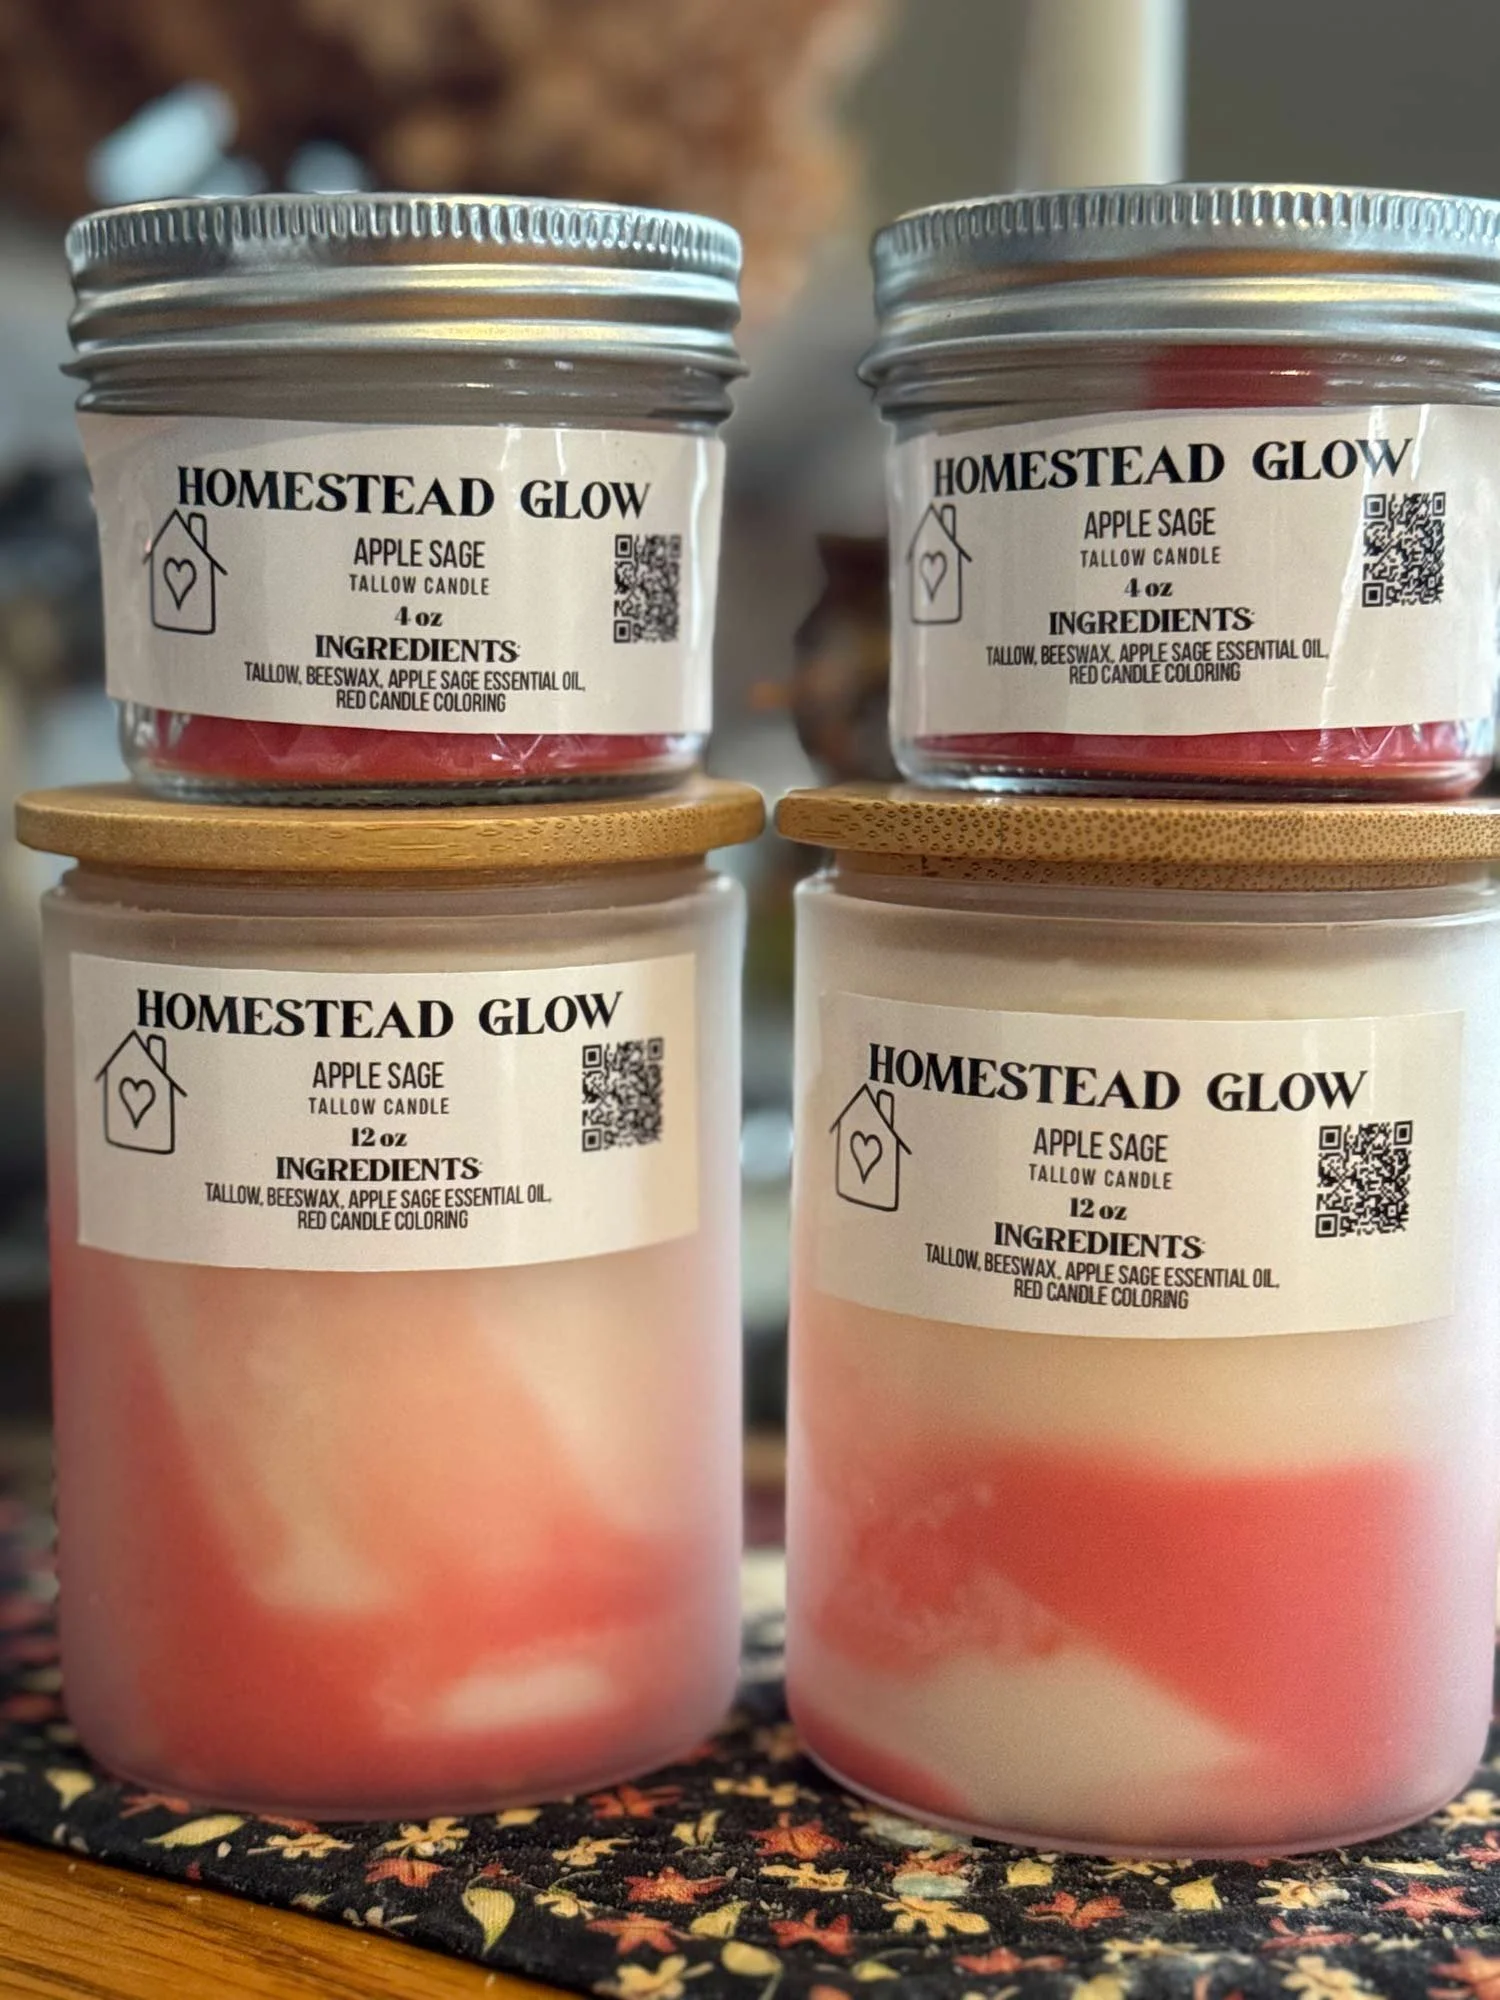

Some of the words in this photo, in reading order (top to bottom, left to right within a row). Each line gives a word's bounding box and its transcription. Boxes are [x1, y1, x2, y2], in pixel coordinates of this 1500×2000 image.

[934, 443, 1225, 497] HOMESTEAD
[1252, 438, 1412, 481] GLOW
[177, 466, 495, 517] HOMESTEAD
[520, 480, 651, 520] GLOW
[1084, 510, 1153, 539] APPLE
[1158, 508, 1216, 536] SAGE
[354, 537, 423, 569] APPLE
[429, 540, 485, 569] SAGE
[1080, 548, 1146, 568] TALLOW
[1153, 546, 1220, 565] CANDLE
[349, 574, 417, 593] TALLOW
[423, 577, 489, 595] CANDLE
[1124, 578, 1140, 598] 4
[1146, 582, 1172, 598] oz
[394, 606, 411, 626] 4
[416, 612, 442, 627] oz
[1119, 643, 1167, 662] APPLE
[1172, 642, 1212, 661] SAGE
[1216, 640, 1298, 661] ESSENTIAL
[388, 669, 436, 689] APPLE
[441, 671, 479, 690] SAGE
[484, 671, 559, 690] ESSENTIAL
[1069, 666, 1098, 685] RED
[1102, 664, 1160, 684] CANDLE
[1165, 663, 1241, 683] COLORING
[336, 690, 365, 709] RED
[370, 690, 430, 711] CANDLE
[434, 692, 506, 712] COLORING
[136, 989, 454, 1039] HOMESTEAD
[478, 992, 623, 1036] GLOW
[312, 1062, 382, 1090] APPLE
[387, 1062, 445, 1090] SAGE
[869, 1043, 1180, 1111] HOMESTEAD
[1207, 1070, 1369, 1112] GLOW
[309, 1097, 376, 1116] TALLOW
[383, 1097, 450, 1115] CANDLE
[351, 1127, 376, 1146] 12
[380, 1133, 407, 1147] oz
[1033, 1128, 1103, 1159] APPLE
[1109, 1132, 1168, 1163] SAGE
[1029, 1164, 1096, 1186] TALLOW
[1104, 1169, 1173, 1190] CANDLE
[349, 1189, 397, 1208] APPLE
[401, 1189, 441, 1208] SAGE
[445, 1186, 524, 1207] ESSENTIAL
[297, 1211, 327, 1230] RED
[331, 1211, 392, 1230] CANDLE
[395, 1210, 468, 1229] COLORING
[1070, 1197, 1094, 1219] 12
[1099, 1205, 1127, 1221] oz
[1065, 1262, 1114, 1283] APPLE
[1118, 1265, 1160, 1285] SAGE
[1165, 1267, 1249, 1288] ESSENTIAL
[1014, 1280, 1042, 1299] RED
[1047, 1283, 1107, 1306] CANDLE
[1112, 1290, 1189, 1309] COLORING
